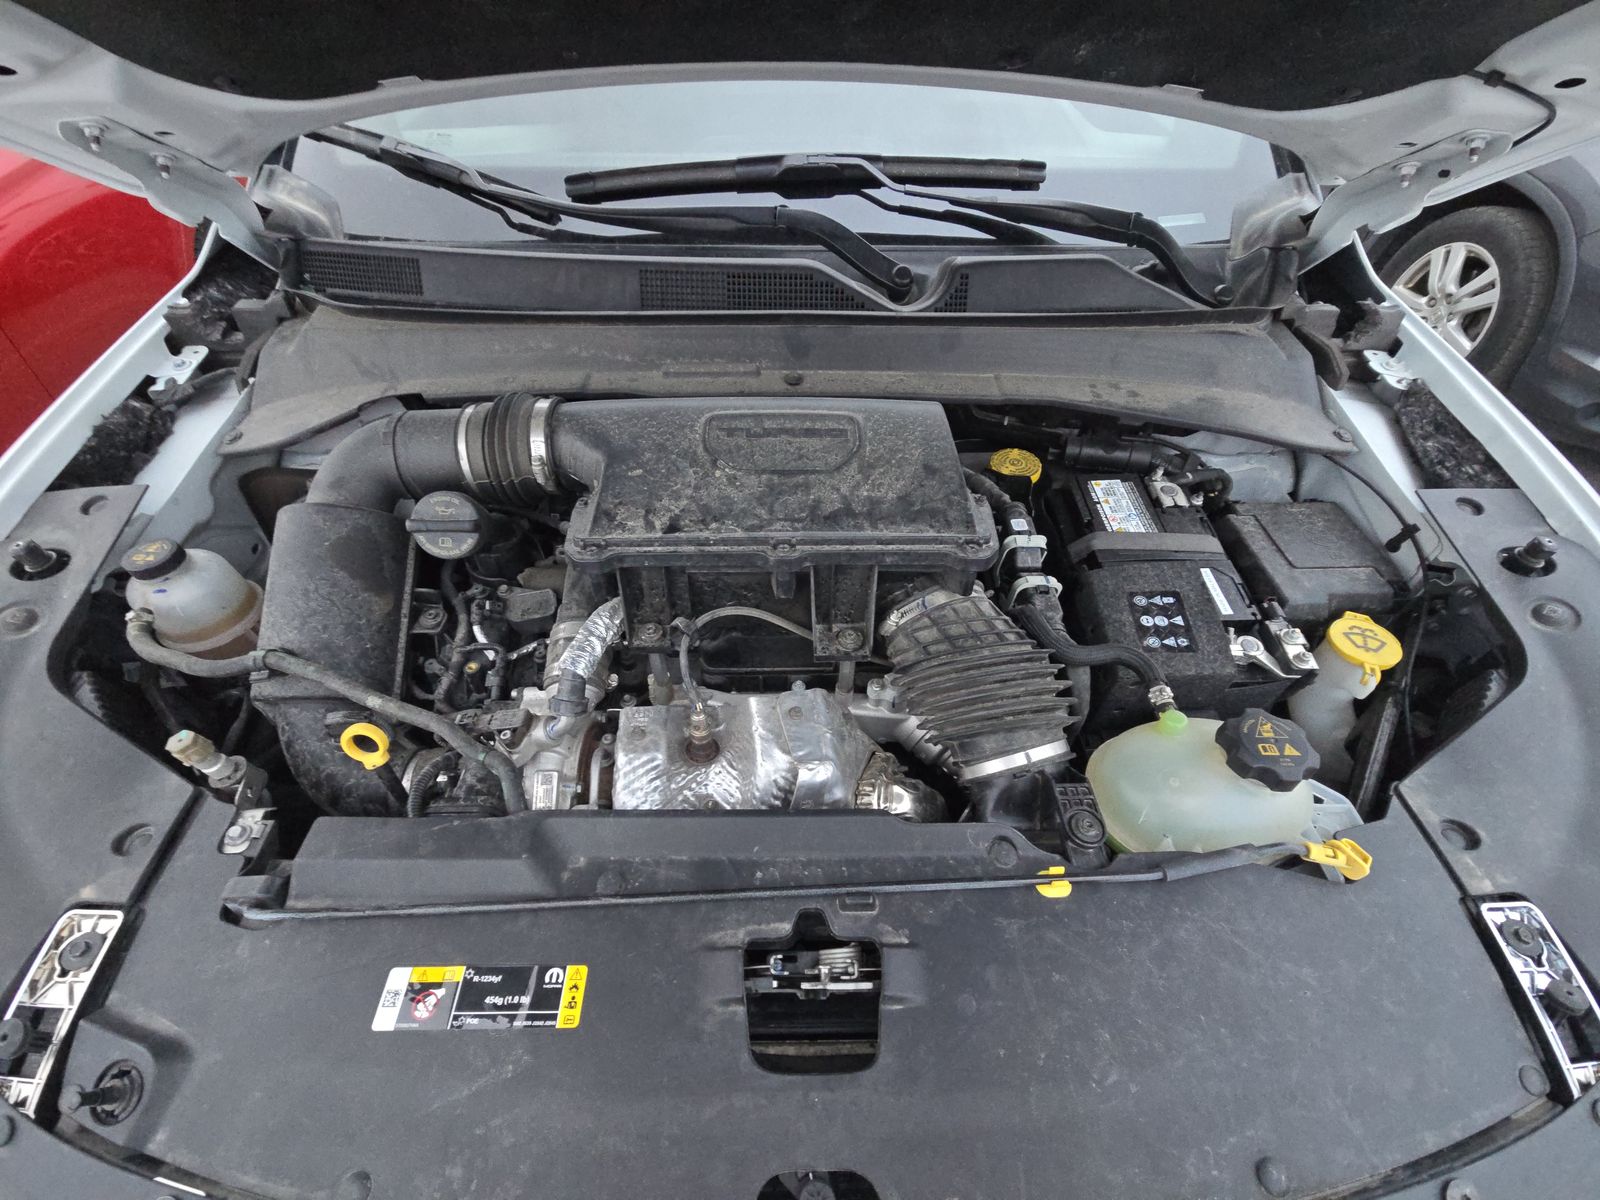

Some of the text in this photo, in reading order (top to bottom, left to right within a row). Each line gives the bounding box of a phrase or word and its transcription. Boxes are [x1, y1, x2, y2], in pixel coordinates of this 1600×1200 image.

[472, 975, 503, 984] R-1234yf
[484, 995, 504, 1006] 454g
[504, 995, 520, 1006] (1.0
